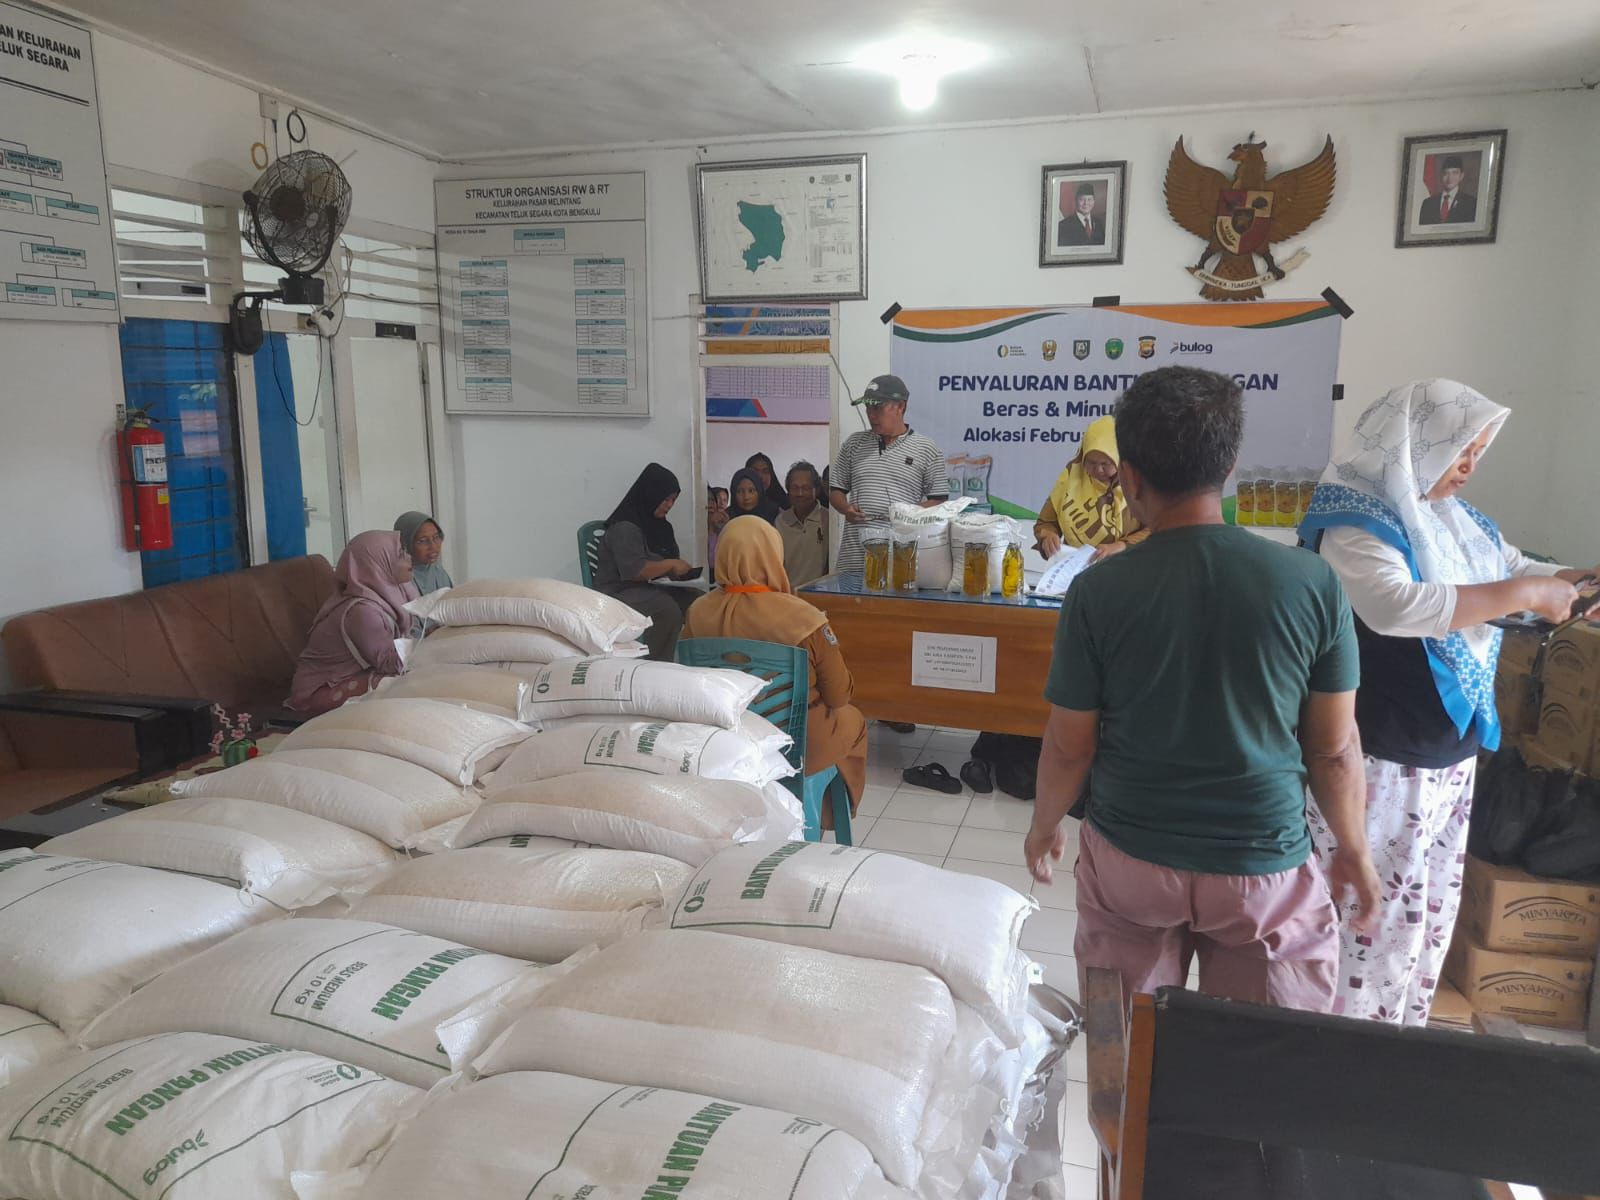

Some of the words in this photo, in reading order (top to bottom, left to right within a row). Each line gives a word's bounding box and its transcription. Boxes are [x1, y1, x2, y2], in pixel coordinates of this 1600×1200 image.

[17, 29, 81, 60] KELURAHAN
[26, 48, 69, 73] SEGARA
[465, 187, 513, 200] STRUKTUR
[516, 185, 570, 198] ORGANISASI
[572, 184, 588, 195] RW
[588, 184, 596, 195] &
[597, 183, 611, 195] RT
[493, 199, 528, 208] KELURAHAN
[528, 198, 548, 207] PASAR
[549, 197, 582, 207] MELINTANG
[475, 211, 510, 220] KECAMATAN
[510, 210, 529, 220] TELUK
[529, 210, 553, 219] SEGARA
[553, 209, 568, 218] KOTA
[569, 208, 601, 217] BENGKULU
[1179, 341, 1213, 355] bulog
[938, 375, 1069, 391] PENYALURAN
[1074, 374, 1137, 391] BANT
[1232, 373, 1279, 391] GAN
[983, 401, 1039, 417] Beras
[1045, 401, 1060, 417] &
[963, 426, 1026, 443] Alokasi
[1030, 427, 1082, 443] Febru
[310, 975, 327, 987] 10
[294, 988, 316, 1006] kg
[311, 975, 346, 1011] MEDIUM
[371, 961, 449, 1021] PANGAN
[94, 1068, 134, 1090] BERAS
[59, 1091, 80, 1104] 10
[104, 1068, 211, 1136] PANGAN
[50, 1089, 98, 1128] MEDIUM
[661, 1102, 742, 1172] BANTUAN
[142, 1137, 199, 1187] bulog
